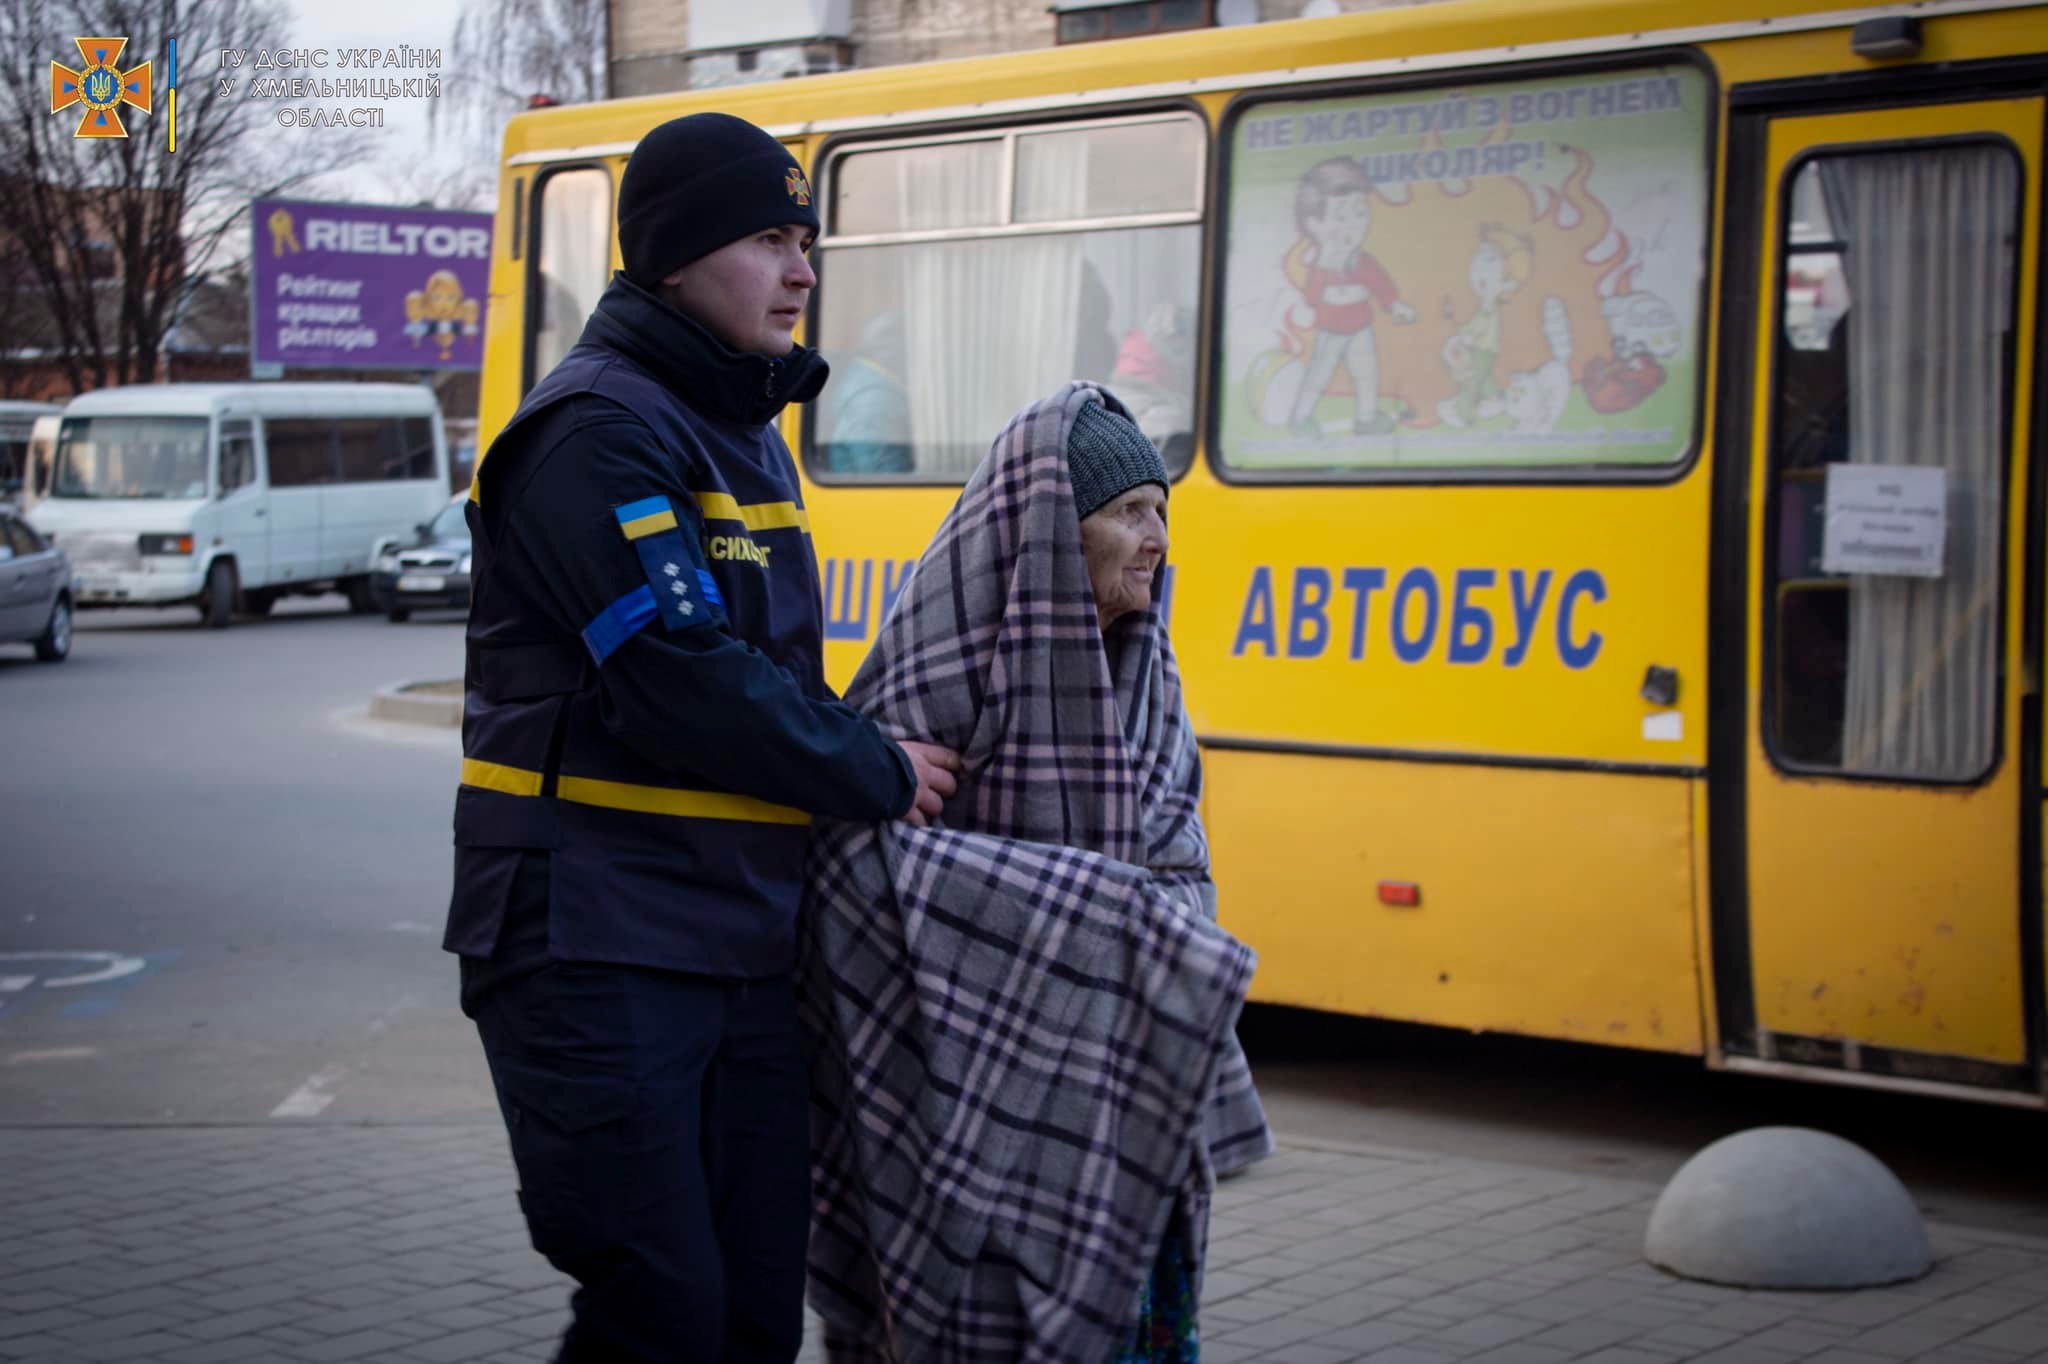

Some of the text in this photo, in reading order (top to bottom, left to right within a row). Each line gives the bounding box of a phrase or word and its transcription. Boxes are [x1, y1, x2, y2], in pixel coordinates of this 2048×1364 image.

[1246, 115, 1294, 149] НЕ
[1300, 94, 1470, 143] ЖАРТУЙ
[1509, 76, 1683, 126] ВОГНЕМ
[1360, 140, 1546, 185] ШКОЛЯР!
[305, 219, 489, 258] RIELTOR
[1232, 566, 1608, 669] АВТОБУС
